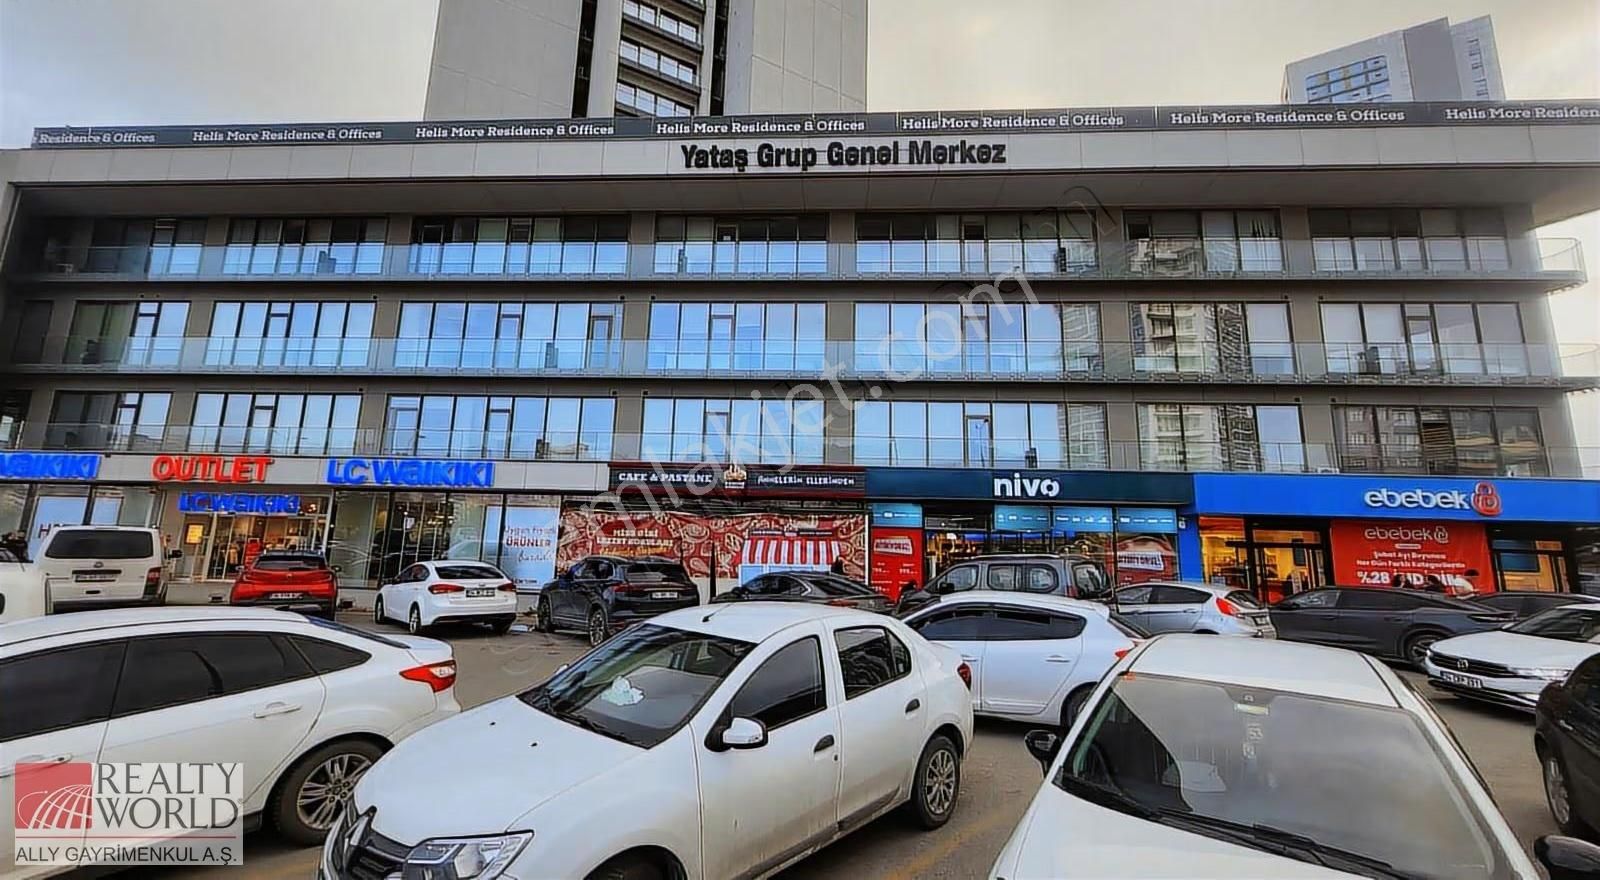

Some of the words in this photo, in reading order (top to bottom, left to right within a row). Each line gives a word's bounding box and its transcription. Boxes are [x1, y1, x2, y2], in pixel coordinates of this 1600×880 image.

[1171, 112, 1209, 124] Helis
[1212, 112, 1251, 123] More
[1255, 110, 1333, 123] Residence
[1337, 111, 1348, 122] &
[1350, 109, 1405, 122] Offices
[1446, 108, 1488, 120] Helis
[1489, 107, 1531, 119] More
[656, 123, 690, 134] Helis
[694, 122, 728, 133] More
[731, 120, 801, 133] Residence
[804, 121, 814, 132] &
[817, 119, 865, 131] Offices
[902, 118, 938, 130] Helis
[941, 117, 979, 128] More
[982, 115, 1056, 128] Residence
[1059, 116, 1070, 127] &
[1072, 114, 1124, 126] Offices
[39, 133, 100, 144] Residence
[102, 132, 112, 143] &
[113, 132, 155, 143] Offices
[193, 131, 224, 142] Helis
[227, 130, 259, 141] More
[261, 129, 325, 140] Residence
[327, 129, 336, 139] &
[338, 128, 382, 139] Offices
[416, 126, 448, 138] Helis
[451, 126, 484, 137] More
[488, 124, 553, 137] Residence
[556, 125, 566, 135] &
[569, 123, 614, 135] Offices
[680, 144, 749, 172] Yataş
[757, 142, 818, 171] Grup
[827, 140, 899, 166] Genel
[909, 139, 1007, 164] Merkez
[152, 454, 273, 482] OUTLET
[327, 458, 369, 484] LC
[619, 472, 648, 481] CAFE
[650, 473, 658, 482] &
[661, 473, 712, 483] PASTANE
[993, 472, 1060, 497] nivo
[179, 491, 213, 513] LC
[1364, 487, 1471, 509] ebebek
[1364, 526, 1433, 541] ebebek
[1356, 571, 1391, 584] %28
